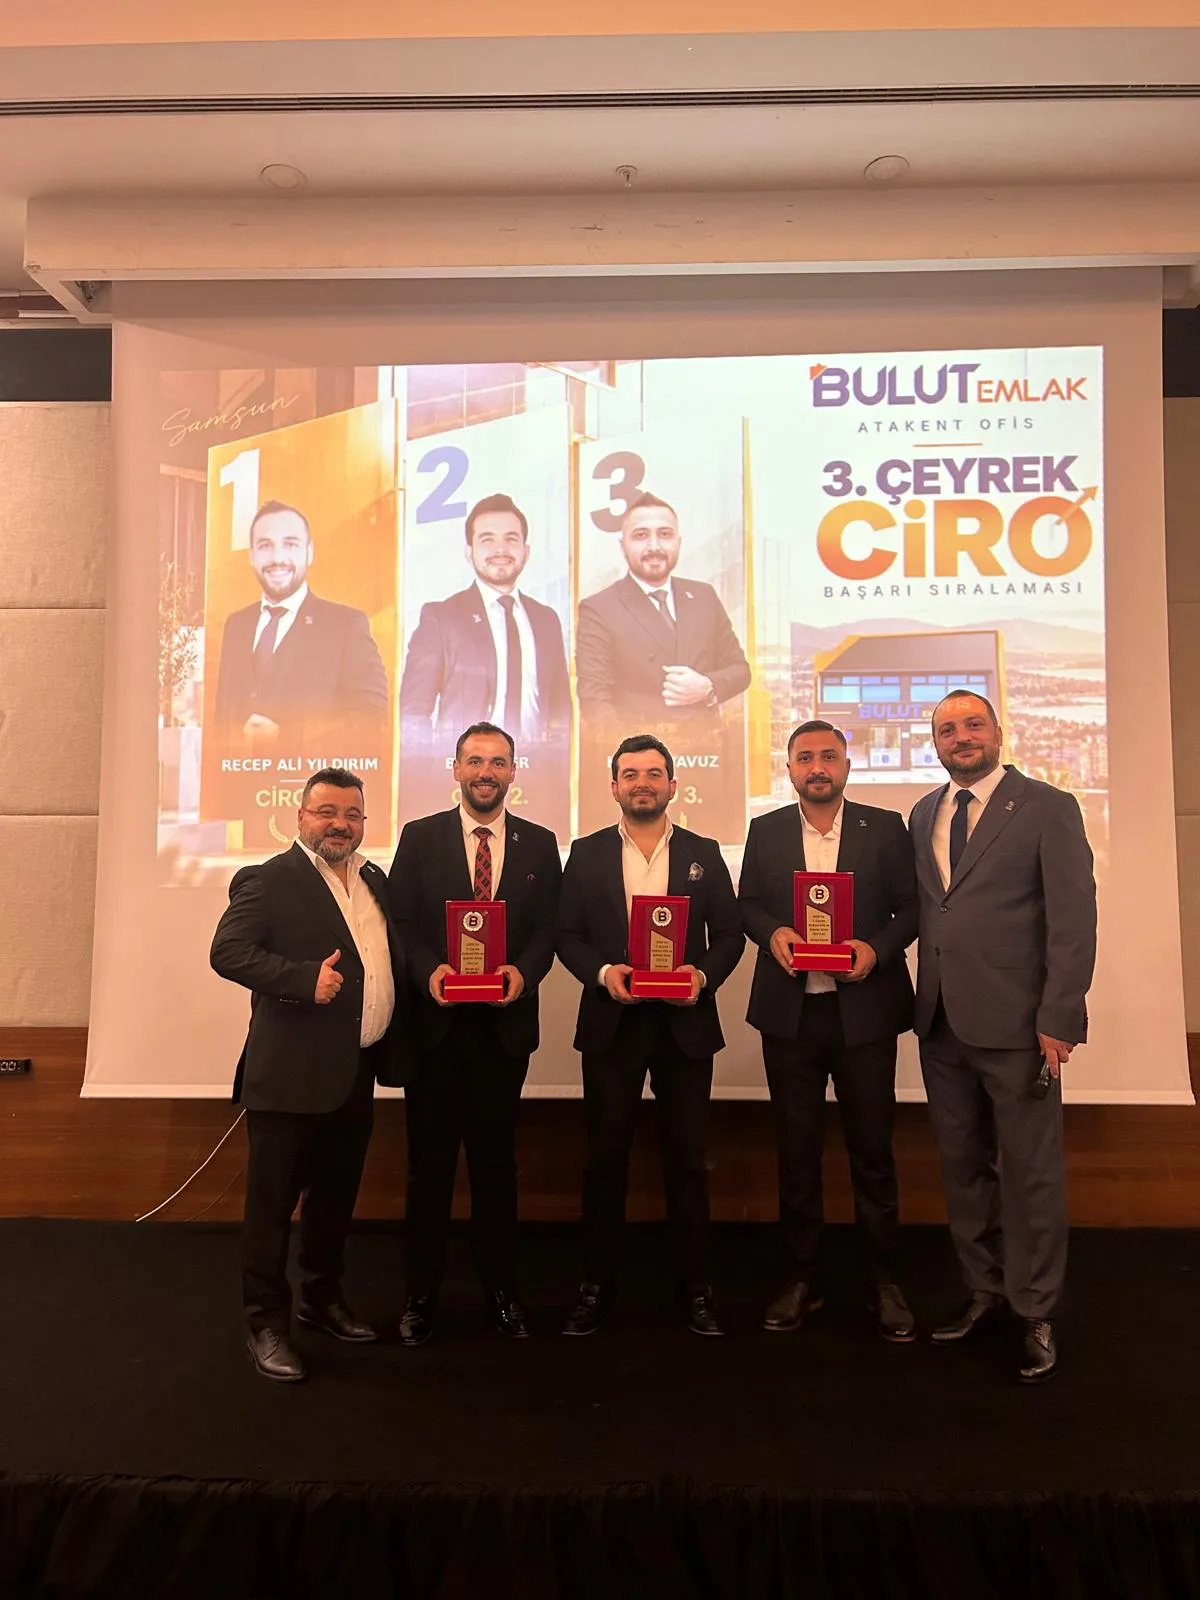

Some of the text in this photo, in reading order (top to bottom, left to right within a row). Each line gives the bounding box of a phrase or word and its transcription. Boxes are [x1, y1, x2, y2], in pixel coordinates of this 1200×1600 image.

[809, 363, 1088, 407] BULUT EMLAK
[162, 393, 299, 447] Samsun
[858, 416, 1034, 433] ATAKENT OFİS
[219, 448, 260, 552] 1
[416, 446, 469, 524] 2
[590, 451, 646, 533] 3
[821, 455, 1079, 505] 3. ÇEYREK
[824, 581, 1082, 600] BAŞARI SIRALAMASI
[221, 755, 378, 772] RECEP ALİ YILDIRIM
[510, 785, 529, 806] 2.
[683, 786, 703, 805] 3.
